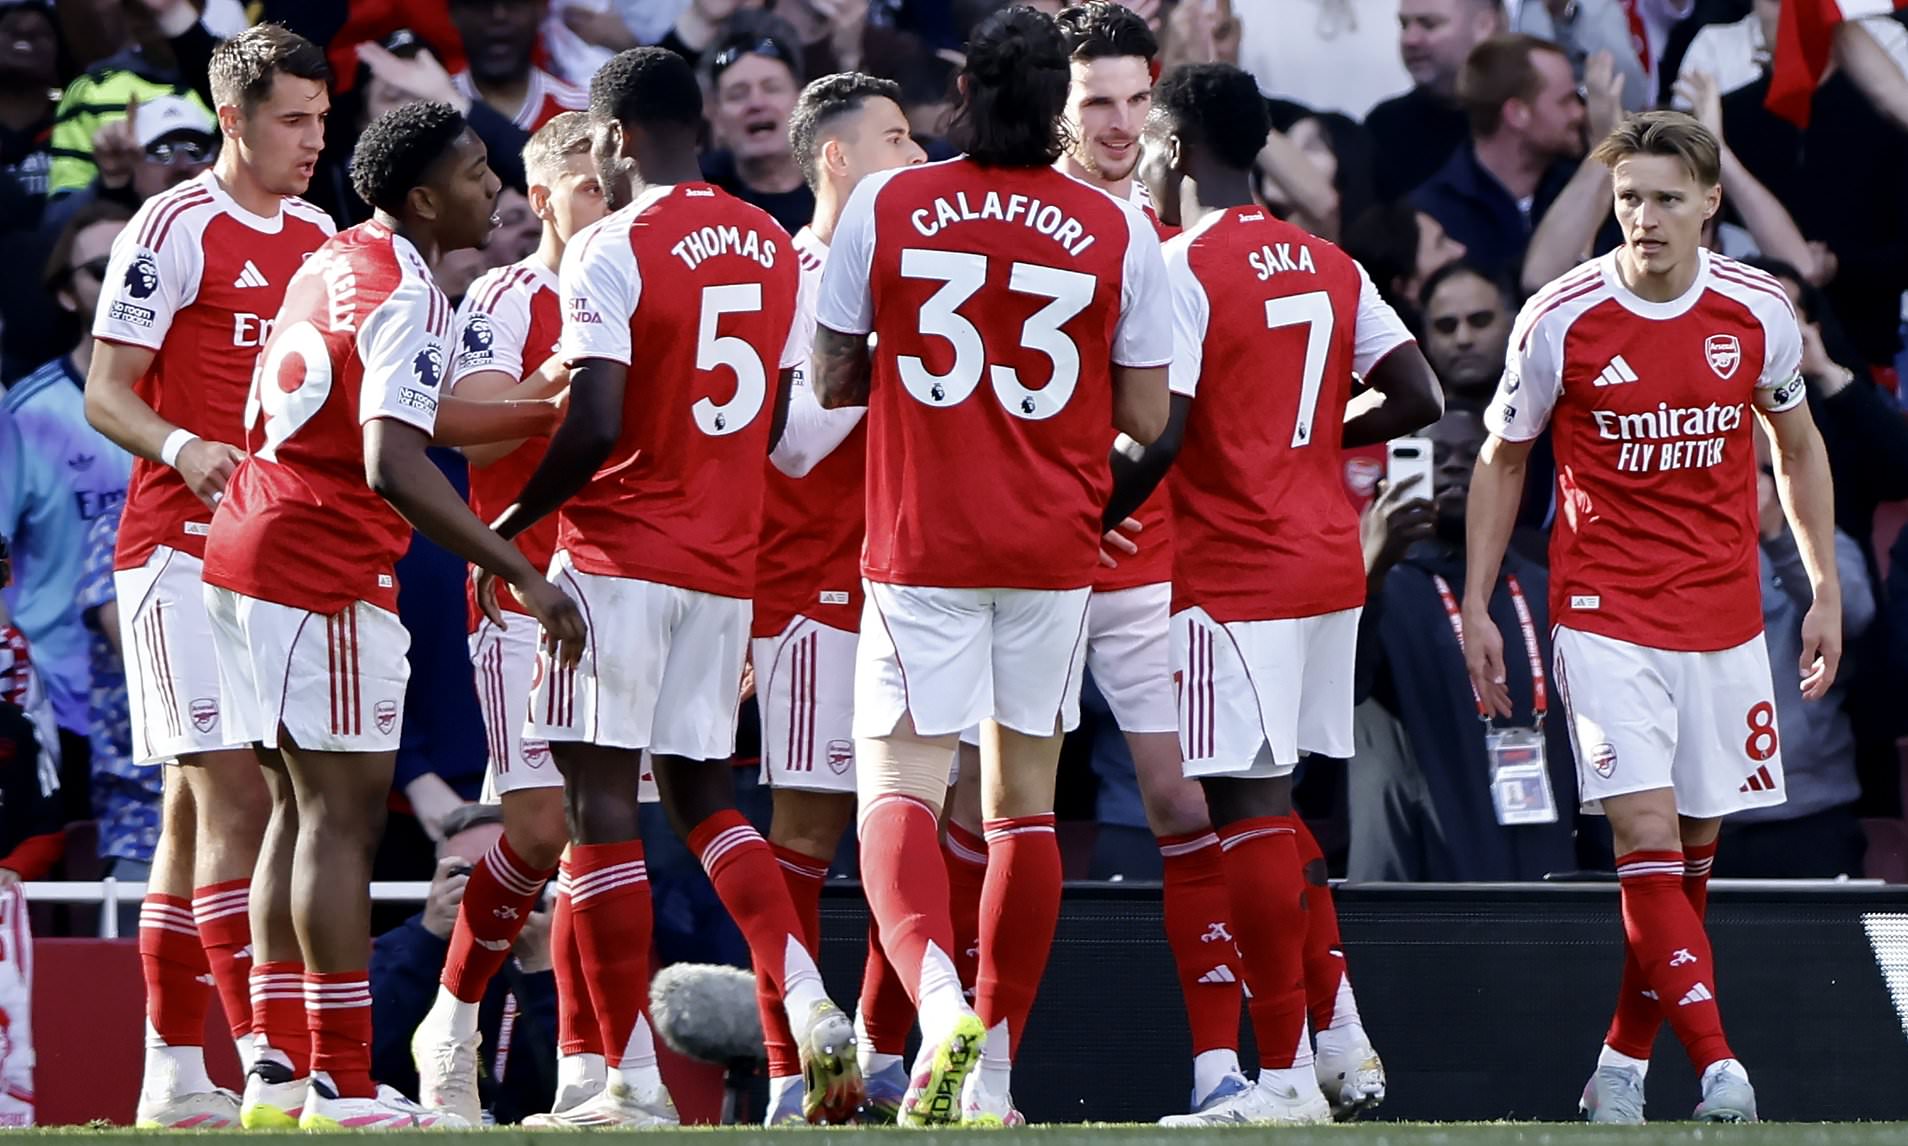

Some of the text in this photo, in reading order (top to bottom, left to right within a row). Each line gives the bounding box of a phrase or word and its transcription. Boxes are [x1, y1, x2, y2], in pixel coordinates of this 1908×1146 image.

[912, 192, 1095, 256] CALAFIORI
[671, 225, 776, 270] THOMAS
[1249, 243, 1316, 281] SAKA
[124, 304, 151, 318] room
[569, 298, 588, 310] SIT
[569, 311, 603, 324] NDA
[897, 248, 1097, 420] 33
[691, 283, 767, 436] 5
[1264, 291, 1334, 448] 7
[1591, 402, 1744, 440] Emirates
[1617, 438, 1725, 472] FLY BETTER
[1745, 701, 1778, 761] 8
